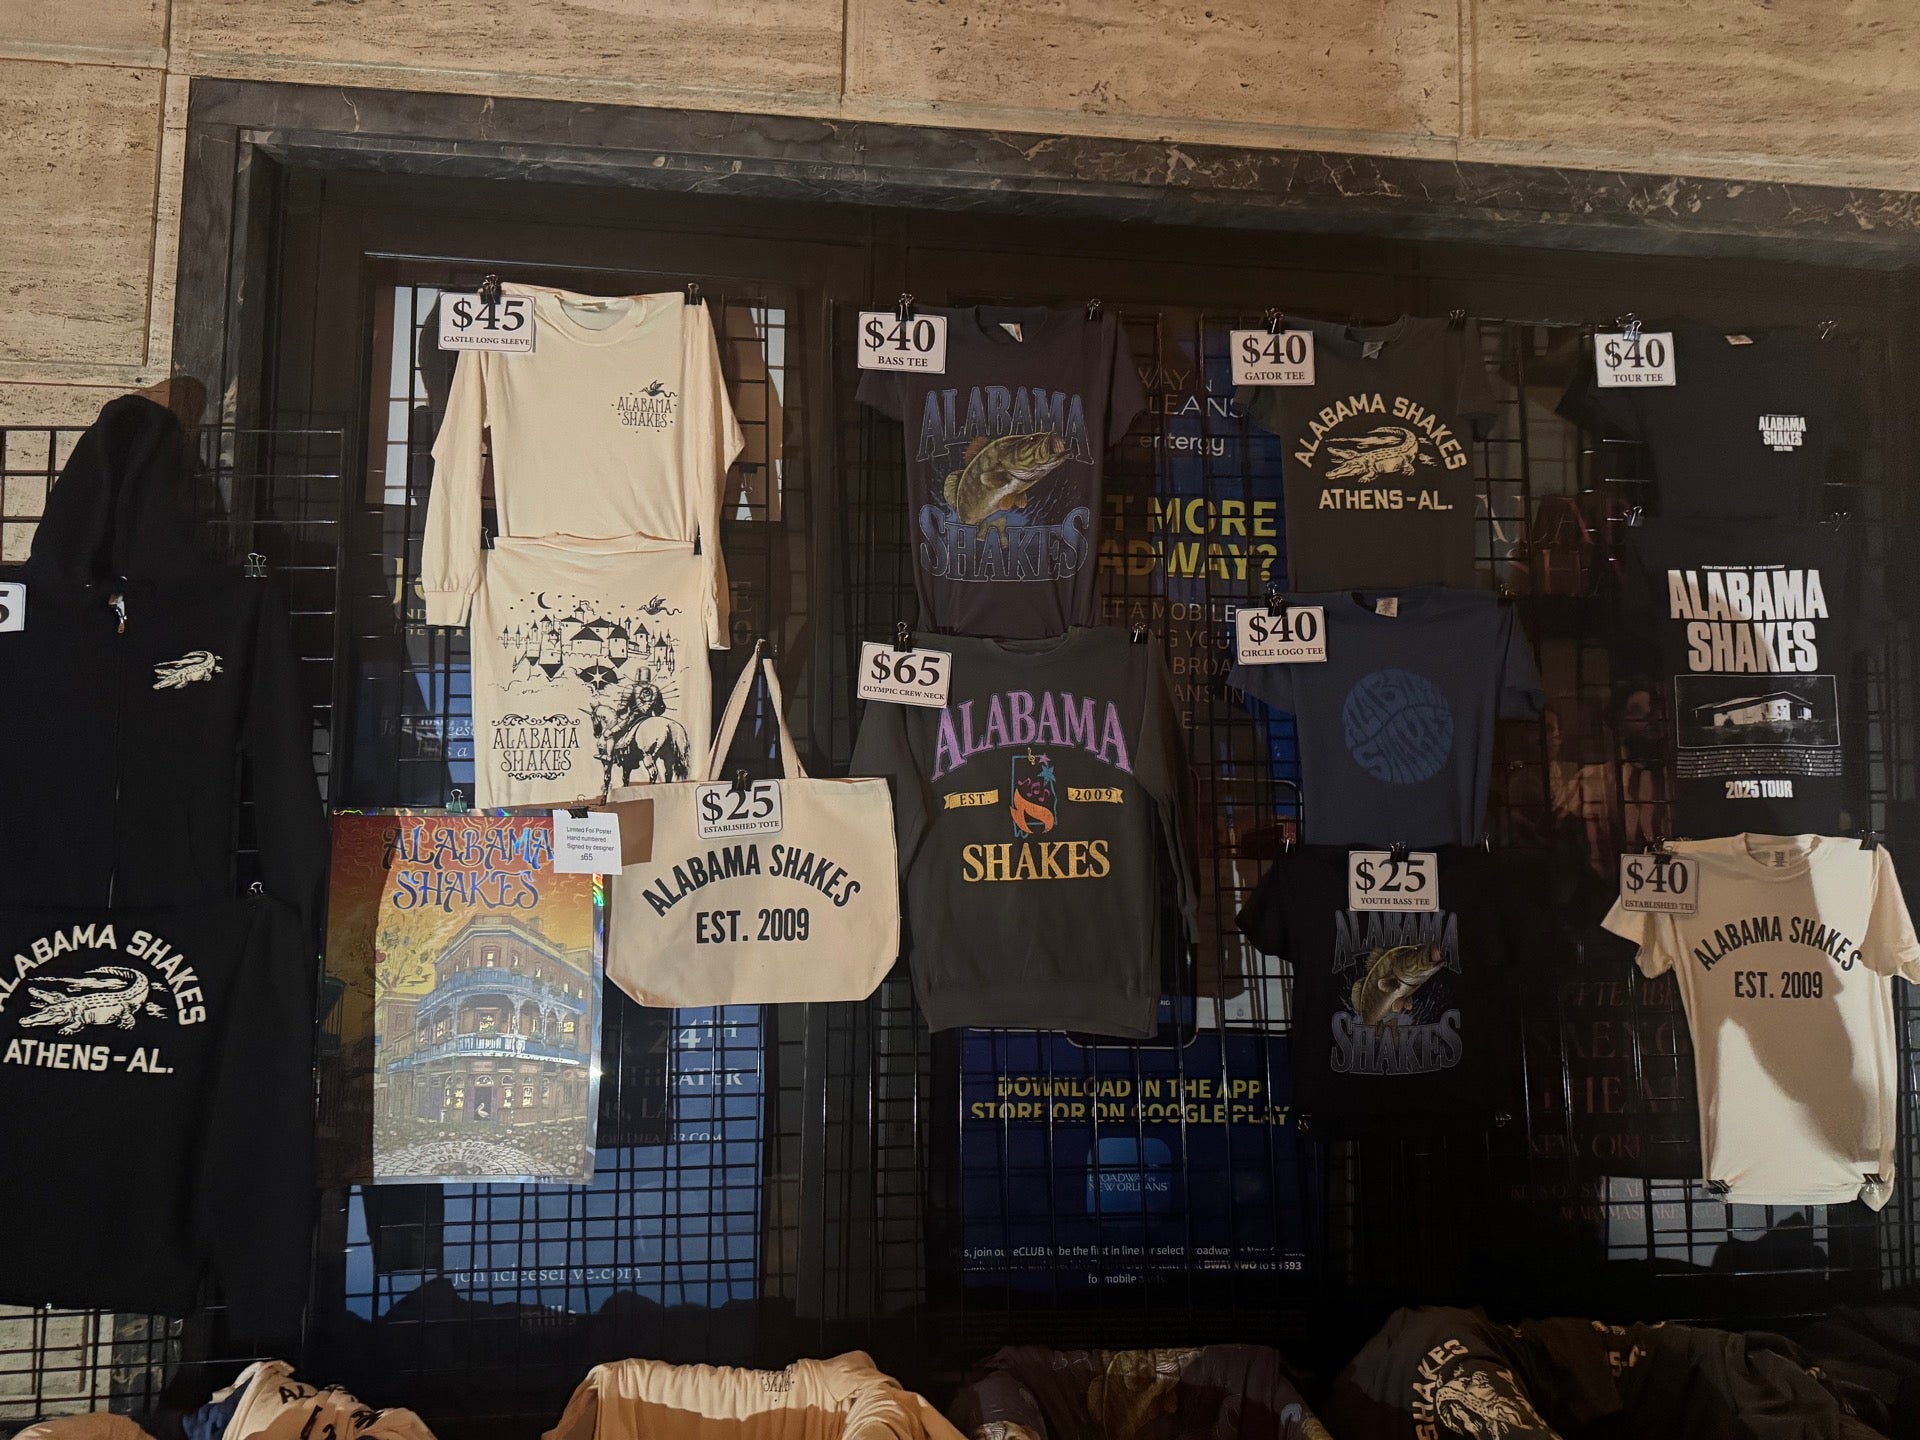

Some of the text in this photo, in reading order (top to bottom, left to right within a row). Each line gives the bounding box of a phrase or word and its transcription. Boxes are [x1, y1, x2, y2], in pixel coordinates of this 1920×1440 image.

[452, 297, 525, 331] $45
[864, 317, 936, 352] $40
[1242, 334, 1307, 367] $40
[878, 356, 928, 367] BASS TEE
[1604, 338, 1665, 371] $40
[1244, 371, 1305, 380] GATOR TEE
[1613, 373, 1664, 382] TOUR TEE
[617, 396, 673, 413] ALABAMA
[622, 411, 668, 428] SHAKES
[916, 385, 1094, 465] ALABAMA
[1294, 392, 1468, 471] ALABAMA SHAKES
[1758, 416, 1807, 431] ALABAMA
[1762, 431, 1803, 446] SHAKES
[1318, 488, 1454, 511] ATHENS-AL.
[1147, 496, 1277, 537] MORE
[917, 505, 1091, 583] SHAKES
[1667, 569, 1830, 621] ALABAMA
[1152, 602, 1236, 622] MOBILE
[1248, 611, 1318, 645] $40
[1241, 646, 1324, 658] CIRCLE LOGO TEE
[1686, 621, 1818, 673] SHAKES
[871, 650, 941, 686] $65
[863, 685, 945, 700] OLYMPIC CREW NECK
[493, 727, 580, 750] ALABAMA
[930, 689, 1135, 783] ALABAMA
[500, 750, 572, 772] SHAKES
[702, 785, 774, 825] $25
[959, 789, 1114, 806] EST. 2009
[1725, 780, 1794, 799] 2025 TOUR
[704, 820, 780, 833] ESTABLISHED TOTE
[382, 825, 554, 869] ALABAMA
[581, 853, 594, 861] $65
[593, 844, 615, 852] designer
[961, 839, 1112, 883] SHAKES
[393, 870, 541, 912] SHAKES
[642, 844, 861, 917] ALABAMA SHAKES
[1355, 858, 1426, 894] $25
[1626, 858, 1688, 894] $40
[1361, 897, 1391, 905] YOUTH
[1625, 900, 1695, 911] ESTABLISHED TEE
[696, 908, 809, 943] EST. 2009
[1331, 910, 1462, 975] ALABAMA
[1693, 916, 1862, 971] ALABAMA SHAKES
[125, 929, 207, 1026] SHAKES
[1735, 971, 1823, 999] EST. 2009
[3, 1038, 175, 1074] ATHENS-AL.
[1330, 1008, 1463, 1075] SHAKES
[997, 1076, 1132, 1097] DOWNLOAD
[1166, 1079, 1212, 1098] THE
[1216, 1079, 1263, 1099] APP
[971, 1102, 1290, 1126] STORE OR ON GOOGLE PLAY
[973, 1247, 993, 1260] join
[1013, 1246, 1045, 1257] eCLUB
[1058, 1246, 1071, 1256] be
[1072, 1246, 1089, 1256] the
[1090, 1245, 1109, 1256] fist
[1111, 1245, 1120, 1255] in
[1121, 1245, 1139, 1256] line
[1157, 1245, 1184, 1256] select
[1104, 1273, 1137, 1284] mobile
